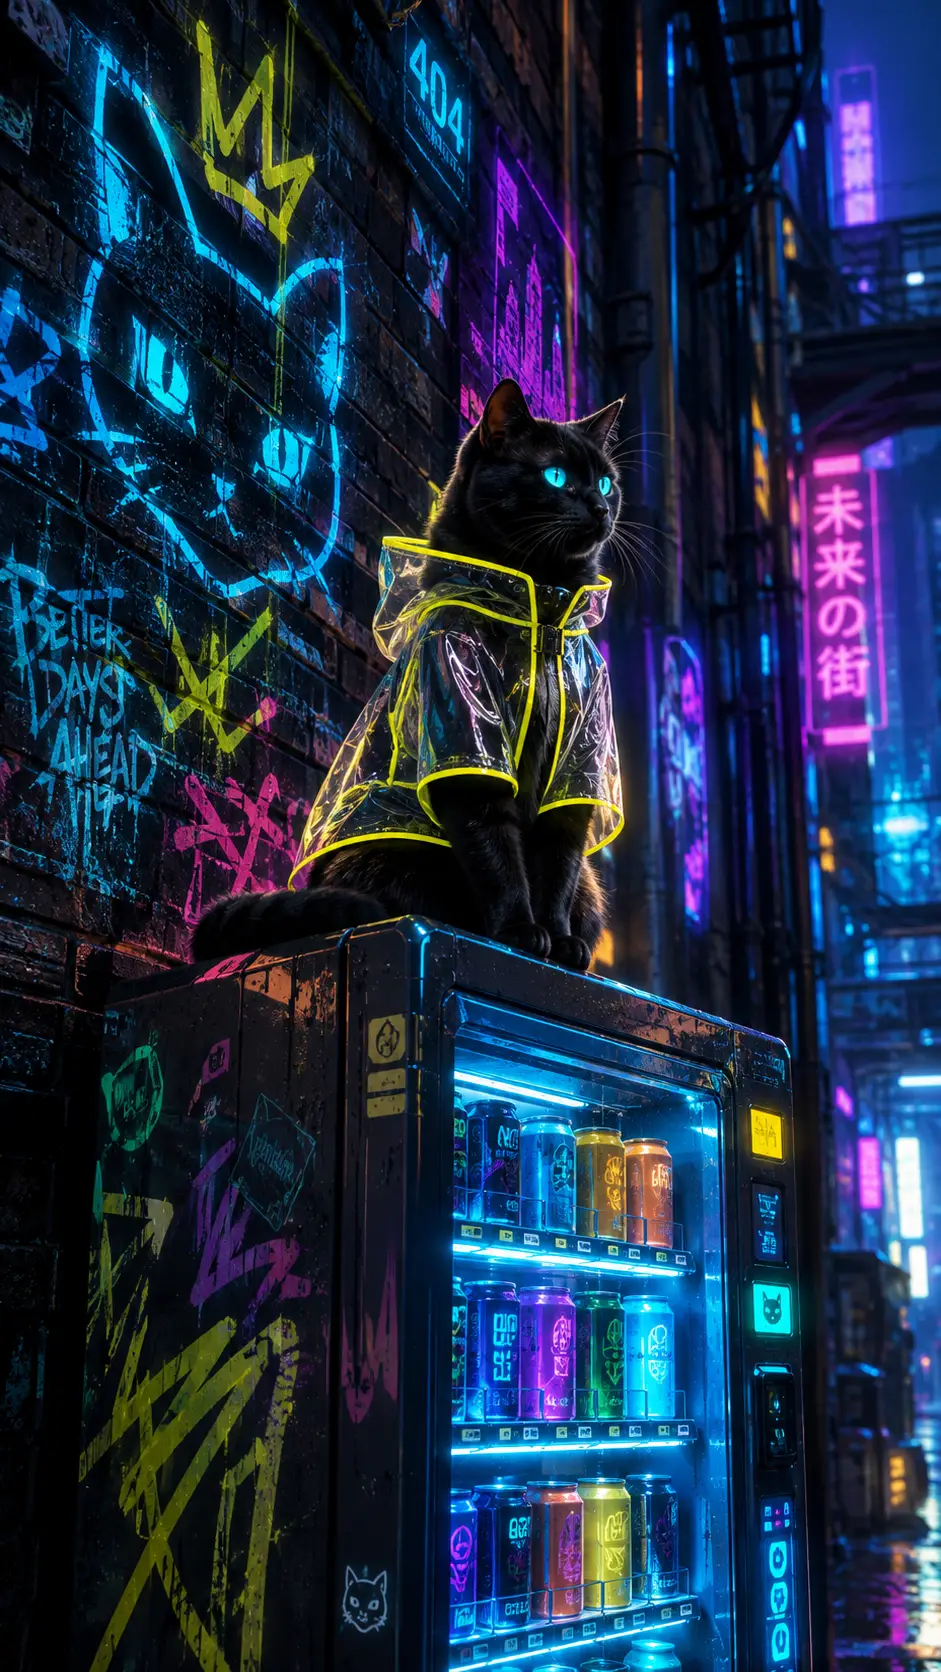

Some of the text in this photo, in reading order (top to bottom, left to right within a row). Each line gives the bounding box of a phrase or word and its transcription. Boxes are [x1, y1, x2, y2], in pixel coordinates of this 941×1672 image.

[409, 38, 465, 155] 404
[4, 562, 132, 661] BETTER
[812, 483, 872, 702] 未来の街
[27, 656, 138, 738] DAYS
[36, 717, 157, 812] AHEAD
